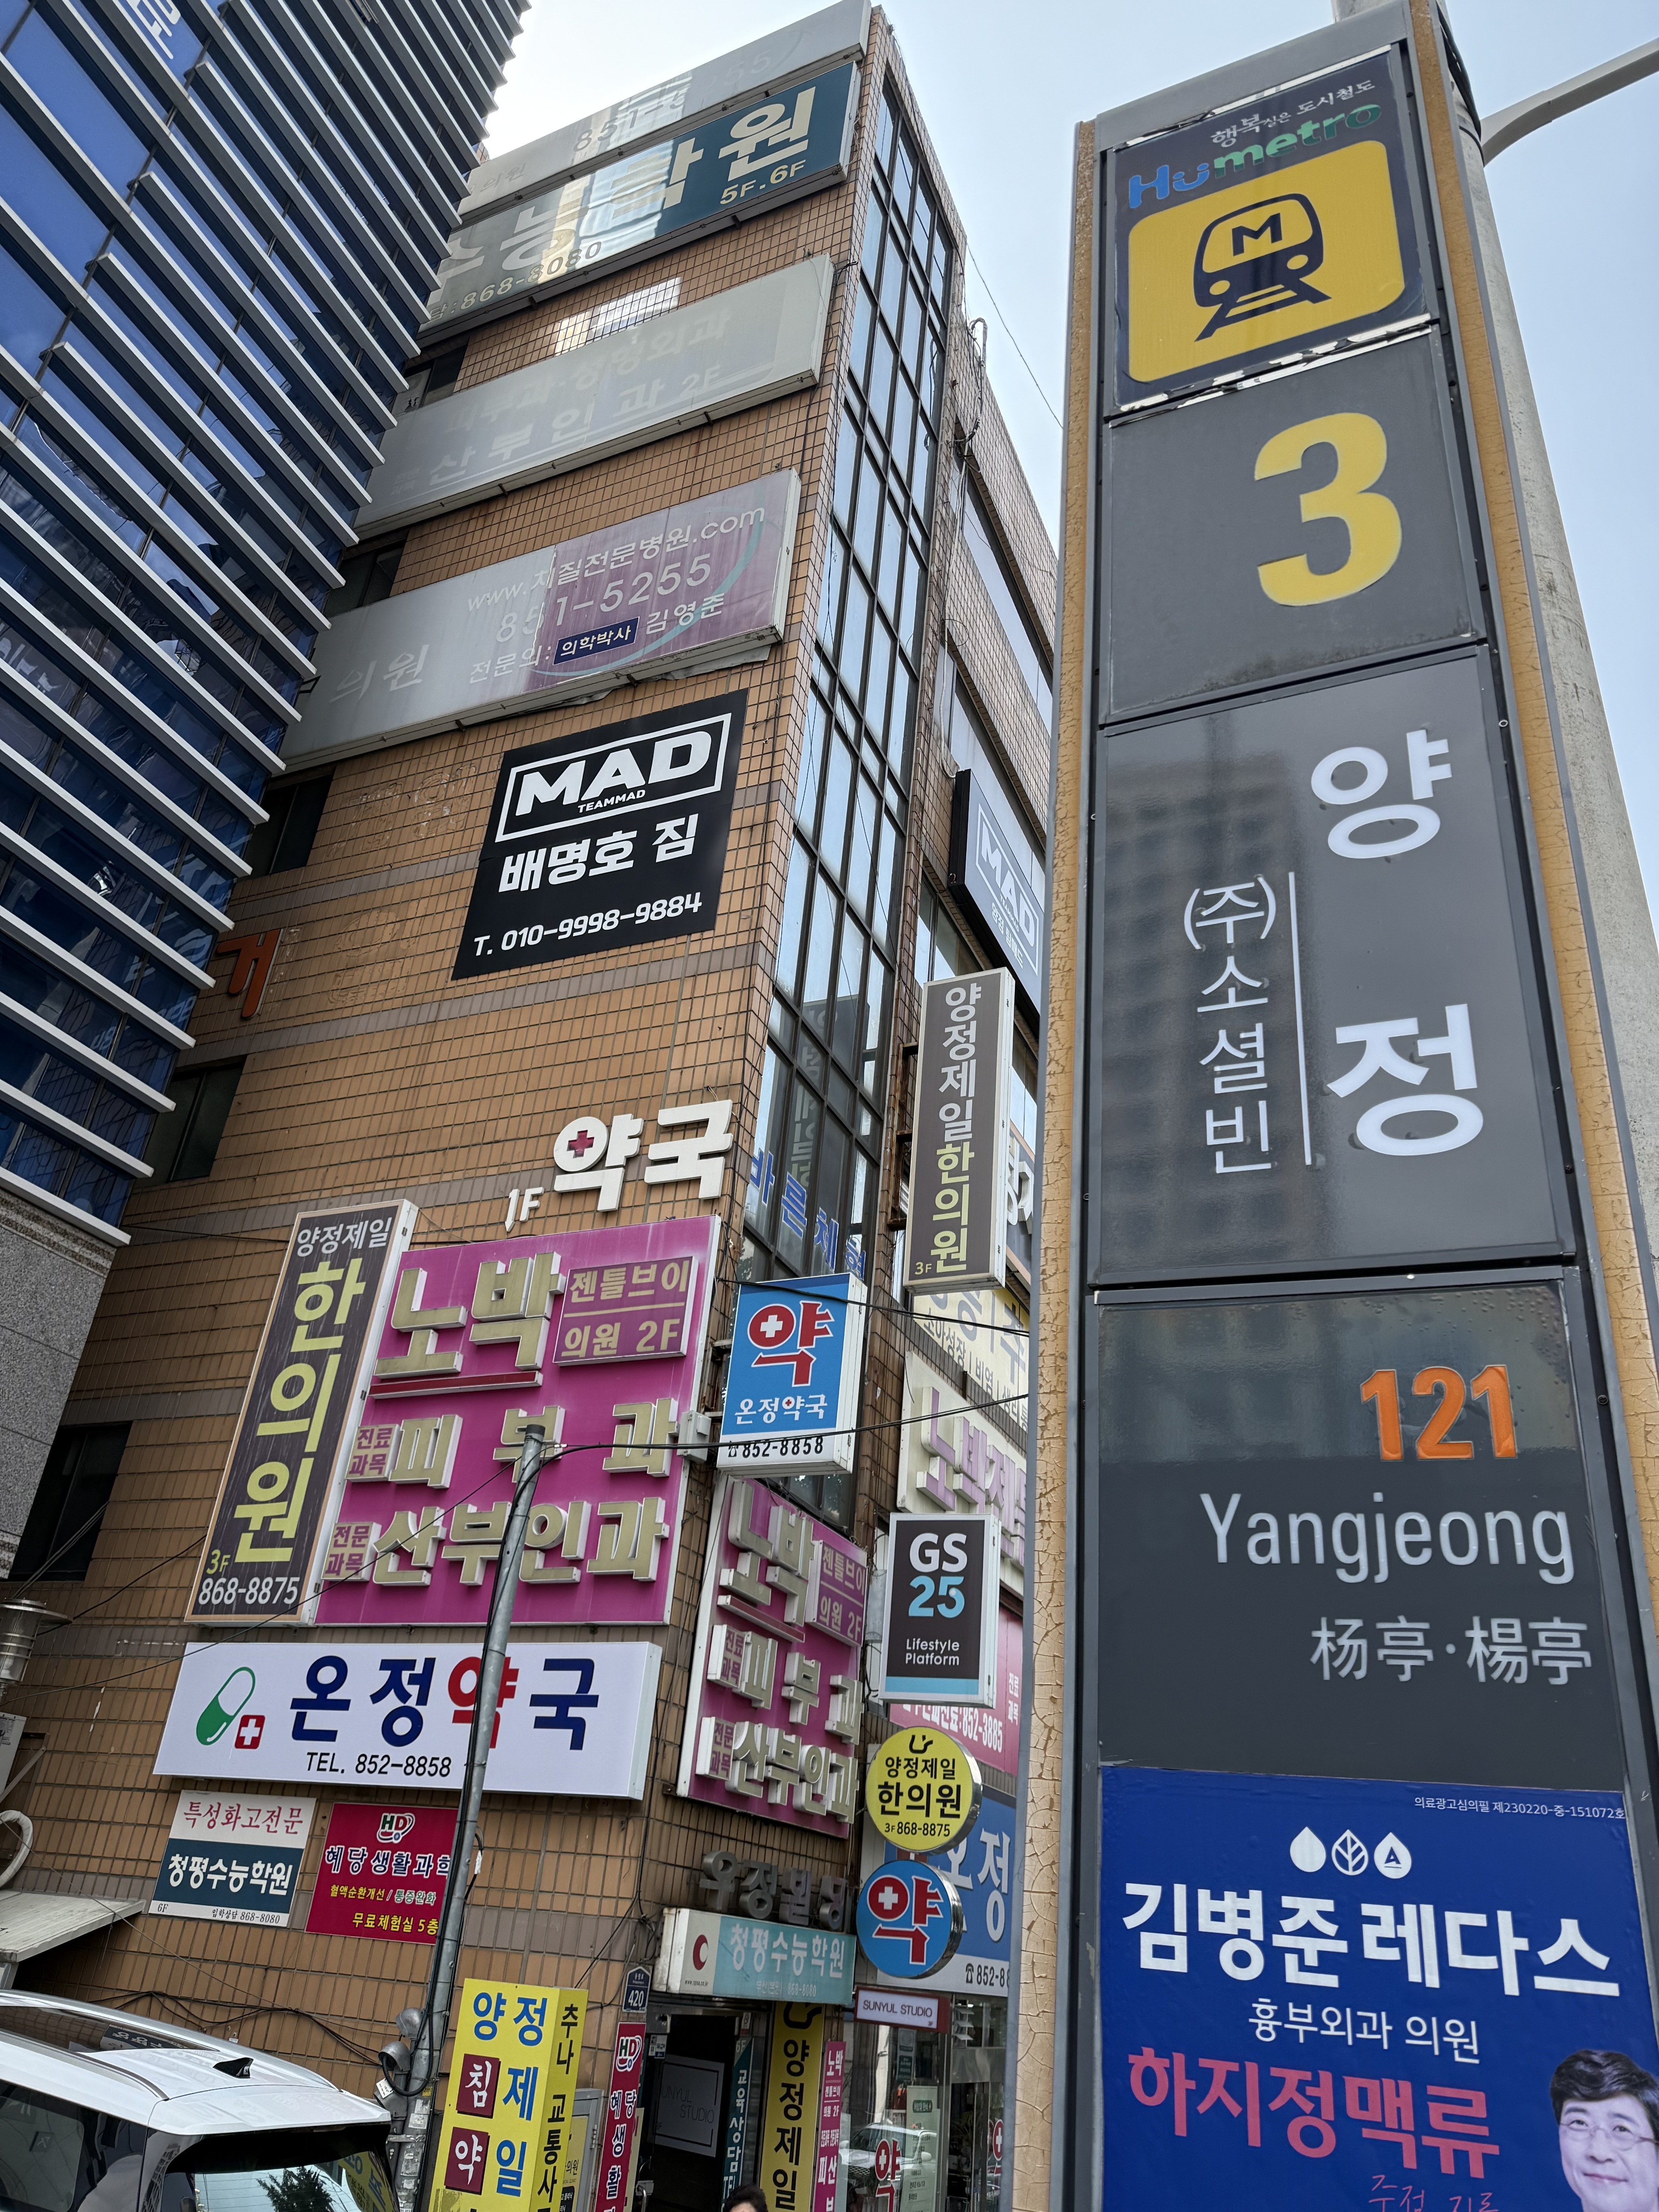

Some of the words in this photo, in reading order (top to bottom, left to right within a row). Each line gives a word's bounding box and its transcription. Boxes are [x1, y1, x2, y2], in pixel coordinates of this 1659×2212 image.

[1296, 80, 1375, 117] 도시철도
[720, 159, 806, 205] 5F.6F
[1255, 412, 1402, 607] 3
[468, 507, 766, 612] www.치질전문병원.com
[496, 553, 711, 643] 851-5255
[560, 624, 632, 658] 의학박사
[646, 592, 725, 635] 김영준
[516, 731, 711, 816] MAD
[578, 790, 646, 813] TEAMMAD
[498, 830, 637, 893] 배명호
[652, 813, 699, 863] 짐
[982, 821, 1036, 948] MAD
[474, 935, 493, 957] T.
[501, 892, 702, 951] 010-9998-9884
[1000, 893, 1019, 933] TEAMMAD
[992, 902, 1005, 935] 양정
[1006, 929, 1024, 969] 팀매드
[1312, 729, 1484, 1156] 양정
[554, 1100, 733, 1212] 약국
[296, 1217, 392, 1258] 양정제일
[570, 1259, 689, 1303] 젠틀브이
[915, 1261, 932, 1276] 3F
[374, 1252, 566, 1379] 노박
[562, 1321, 621, 1358] 의원
[636, 1318, 681, 1353] 2F
[747, 1300, 835, 1388] 약
[234, 1257, 366, 1564] 한의원
[735, 1394, 828, 1425] 온정약국
[1360, 1364, 1517, 1462] 121
[357, 1426, 393, 1450] 진료
[742, 1436, 824, 1459] 852-8858
[347, 1453, 388, 1478] 과목
[333, 1524, 370, 1548] 전문
[373, 1497, 670, 1587] 산부인과
[720, 1481, 815, 1626] 노박
[909, 1532, 968, 1573] GS
[1199, 1492, 1575, 1585] Yangjeong
[206, 1549, 229, 1575] 3F
[325, 1553, 364, 1577] 과목
[823, 1546, 866, 1596] 젠틀브이
[198, 1576, 300, 1606] 868-8875
[908, 1575, 965, 1619] 25
[819, 1595, 843, 1632] 의원
[847, 1611, 862, 1642] 2F
[905, 1651, 960, 1667] Platform
[906, 1638, 960, 1653] Lifestyle
[290, 1655, 599, 1751] 온정약국
[733, 1632, 864, 1745] 피부과
[306, 1752, 345, 1774] TEL.
[355, 1754, 452, 1778] 852-8858
[725, 1721, 859, 1824] 산부인과
[885, 1757, 956, 1781] 양정제일
[184, 1802, 304, 1835] 특성화고전문
[878, 1781, 961, 1819] 한의원
[1414, 1797, 1490, 1813] 의료광고심의필
[1493, 1801, 1625, 1820] 제230220-중-151072호
[896, 1821, 951, 1838] 868-8875
[168, 1853, 293, 1896] 청평수능학원
[157, 1903, 168, 1913] 6F
[212, 1908, 238, 1920] 입학상담
[240, 1911, 280, 1924] 868-8080
[352, 1912, 414, 1933] 무료체험실
[867, 1875, 944, 1965] 약
[730, 1923, 845, 1978] 청평수능학원
[628, 1990, 644, 2007] 420
[787, 1982, 816, 1997] 868-8080
[863, 2000, 898, 2014] SUNYUL
[900, 2004, 933, 2018] STUDIO
[1249, 1997, 1392, 2050] 흉부외과
[1405, 2014, 1481, 2064] 의원
[465, 2060, 492, 2109] 침
[661, 2084, 692, 2104] UNYUL
[679, 2104, 715, 2124] STUDIO
[1128, 2046, 1500, 2179] 하지정맥류
[455, 2134, 483, 2185] 약
[537, 2094, 566, 2212] 교통사
[565, 2159, 579, 2175] 의원
